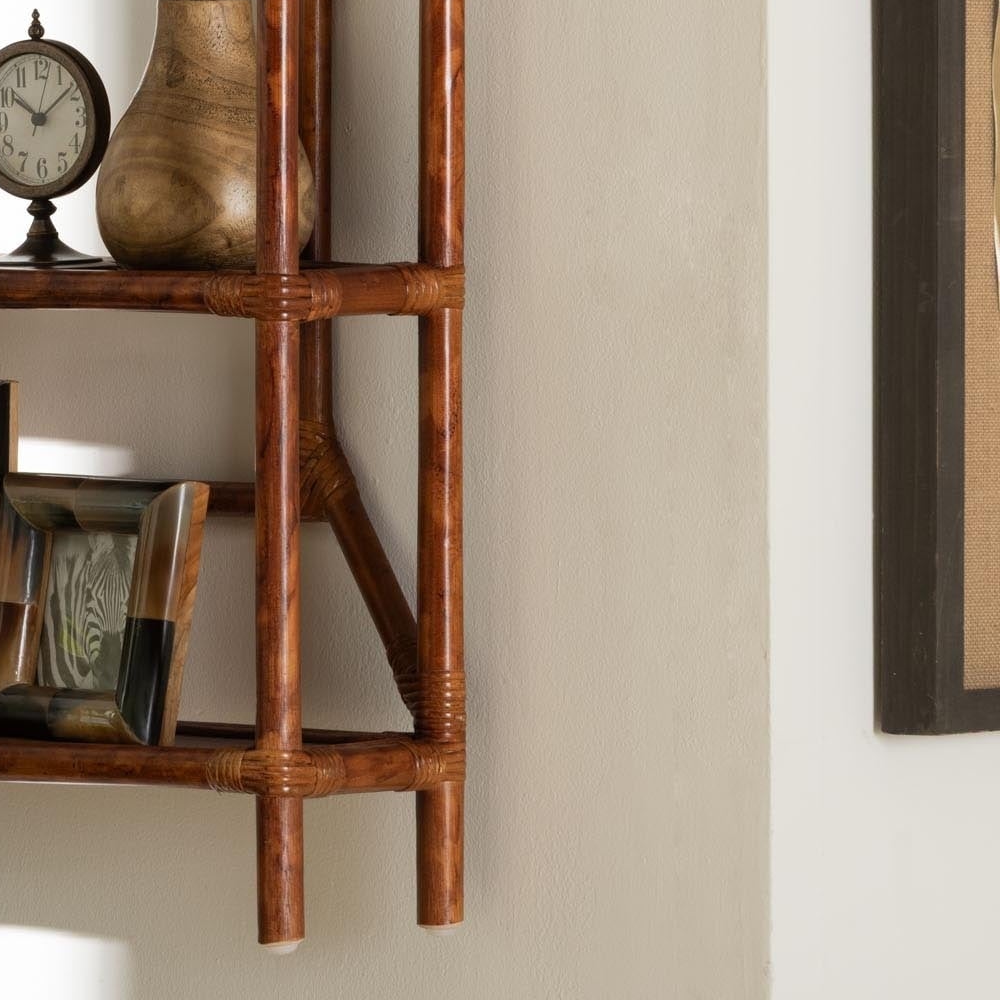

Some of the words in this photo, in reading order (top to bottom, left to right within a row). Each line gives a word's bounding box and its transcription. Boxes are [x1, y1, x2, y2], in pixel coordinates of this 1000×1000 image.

[16, 67, 26, 88] 11
[34, 58, 49, 80] 12
[56, 65, 63, 85] 1
[1, 87, 14, 108] 10
[70, 81, 80, 101] 2
[75, 106, 86, 128] 3
[2, 134, 14, 156] 8
[68, 132, 80, 153] 4
[18, 151, 29, 172] 7
[36, 157, 48, 179] 6
[57, 152, 68, 173] 5
